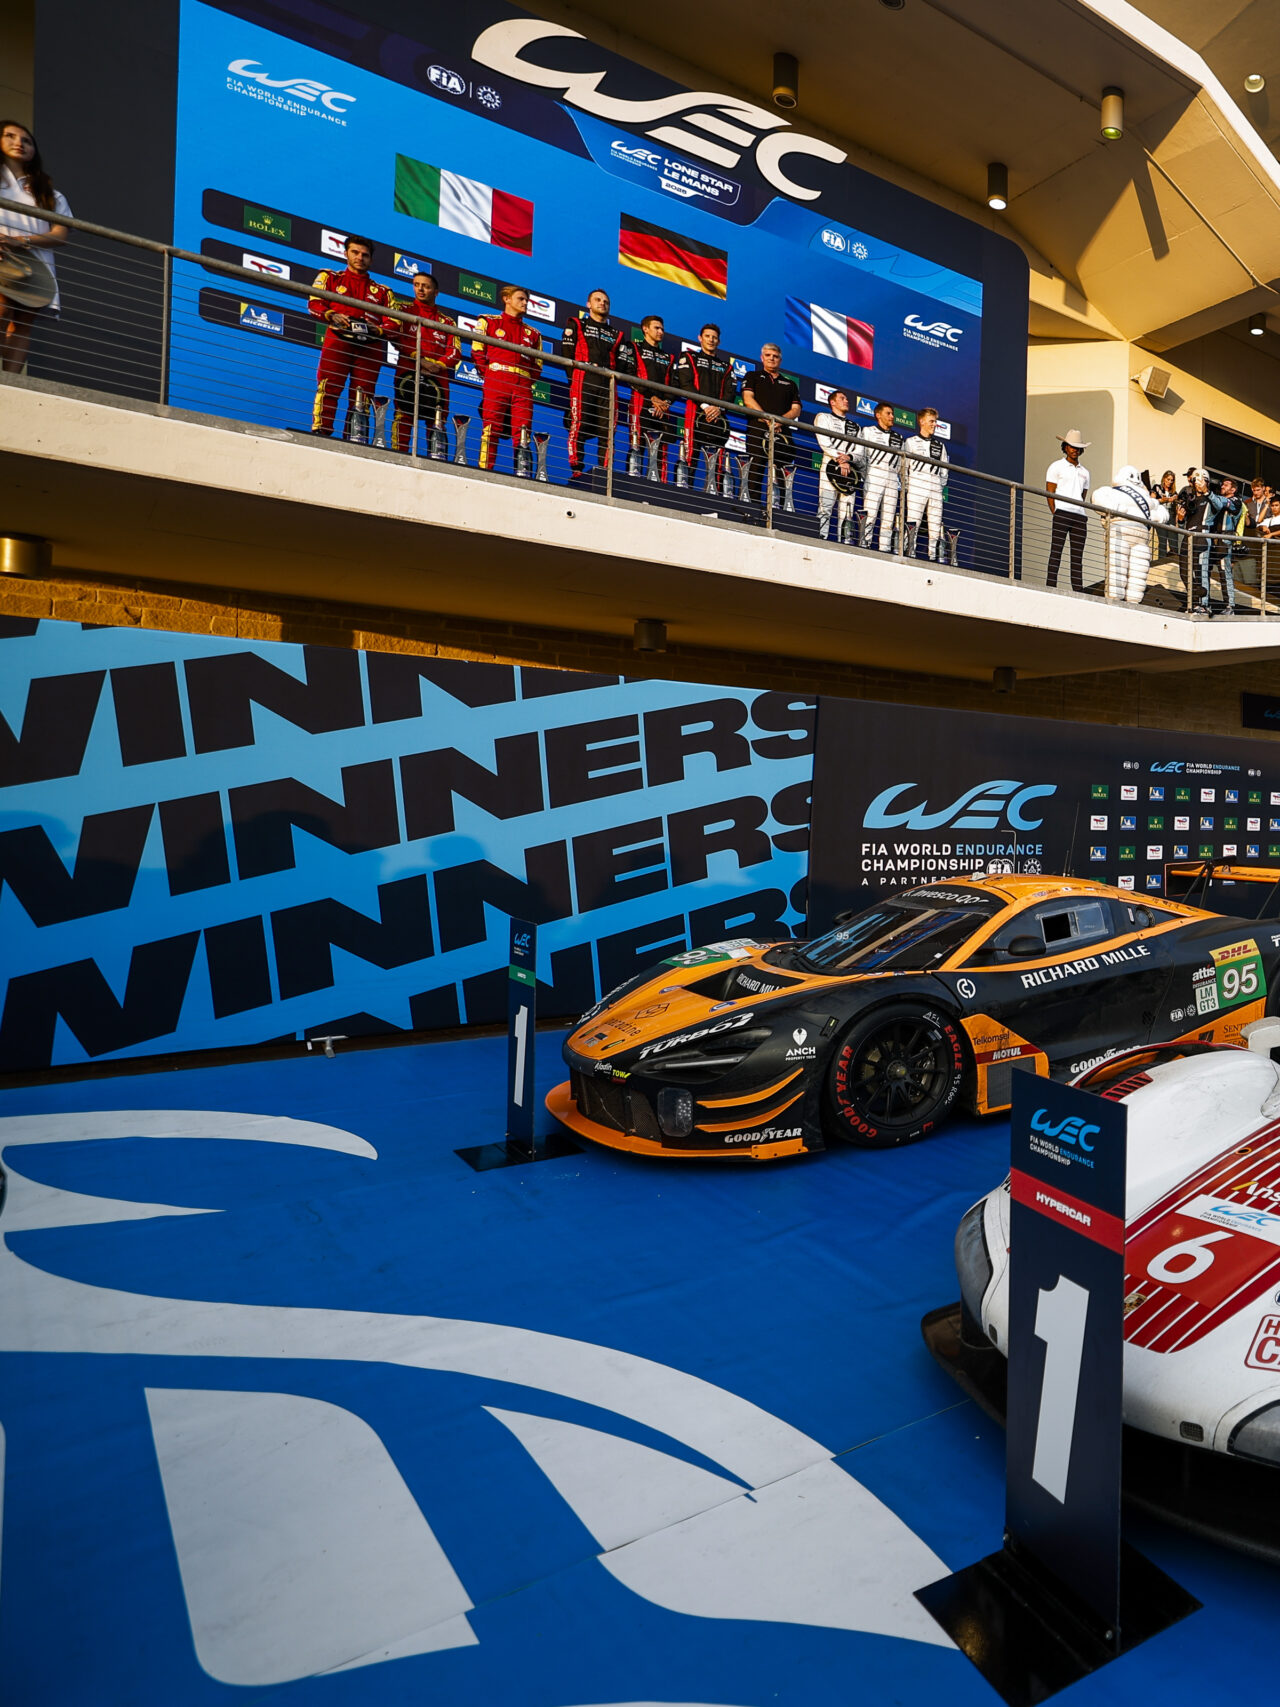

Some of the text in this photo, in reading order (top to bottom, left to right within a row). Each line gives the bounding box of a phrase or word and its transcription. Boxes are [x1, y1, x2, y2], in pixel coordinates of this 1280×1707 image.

[227, 59, 357, 113] WEC
[429, 66, 461, 93] FIA
[226, 83, 307, 116] CHAMPIONSHIP
[226, 77, 348, 127] FIA WORLD ENDURANCE
[471, 18, 848, 200] WEC
[611, 140, 662, 165] WEC
[663, 168, 720, 196] LE MANS
[664, 158, 734, 193] LONE STAR
[248, 219, 286, 238] ROLEX
[822, 230, 844, 250] FIA
[462, 286, 493, 300] ROLEX
[242, 317, 281, 332] MICHELIN
[904, 314, 964, 343] WEC
[895, 417, 914, 426] ROLEX
[1150, 761, 1185, 773] WEC
[862, 780, 1058, 831] WEC
[861, 843, 1043, 856] FIA WORLD ENDURANCE
[861, 858, 984, 872] CHAMPIONSHIP
[861, 877, 869, 886] A
[1218, 944, 1252, 961] DHL
[1020, 944, 1151, 989] RICHARD MILLE
[1192, 963, 1216, 982] attis
[736, 973, 758, 991] RICHARD
[1199, 986, 1213, 999] LM
[1223, 963, 1258, 999] 95
[1170, 1009, 1184, 1022] FIA
[1199, 999, 1216, 1012] GT3
[943, 1025, 962, 1071] EAGLE
[972, 1030, 1011, 1046] Telkomsel
[513, 1005, 528, 1107] 1
[785, 1046, 816, 1057] ANCH
[993, 1047, 1021, 1061] MOTUL
[724, 1127, 803, 1144] GOODYEAR
[1030, 1108, 1101, 1152] WEC
[1030, 1135, 1095, 1169] FIA WORLD ENDURANCE
[1030, 1143, 1071, 1166] CHAMPIONSHIP
[1036, 1191, 1092, 1227] HYPERCAR
[1146, 1231, 1236, 1284] 6
[1031, 1275, 1090, 1506] 1
